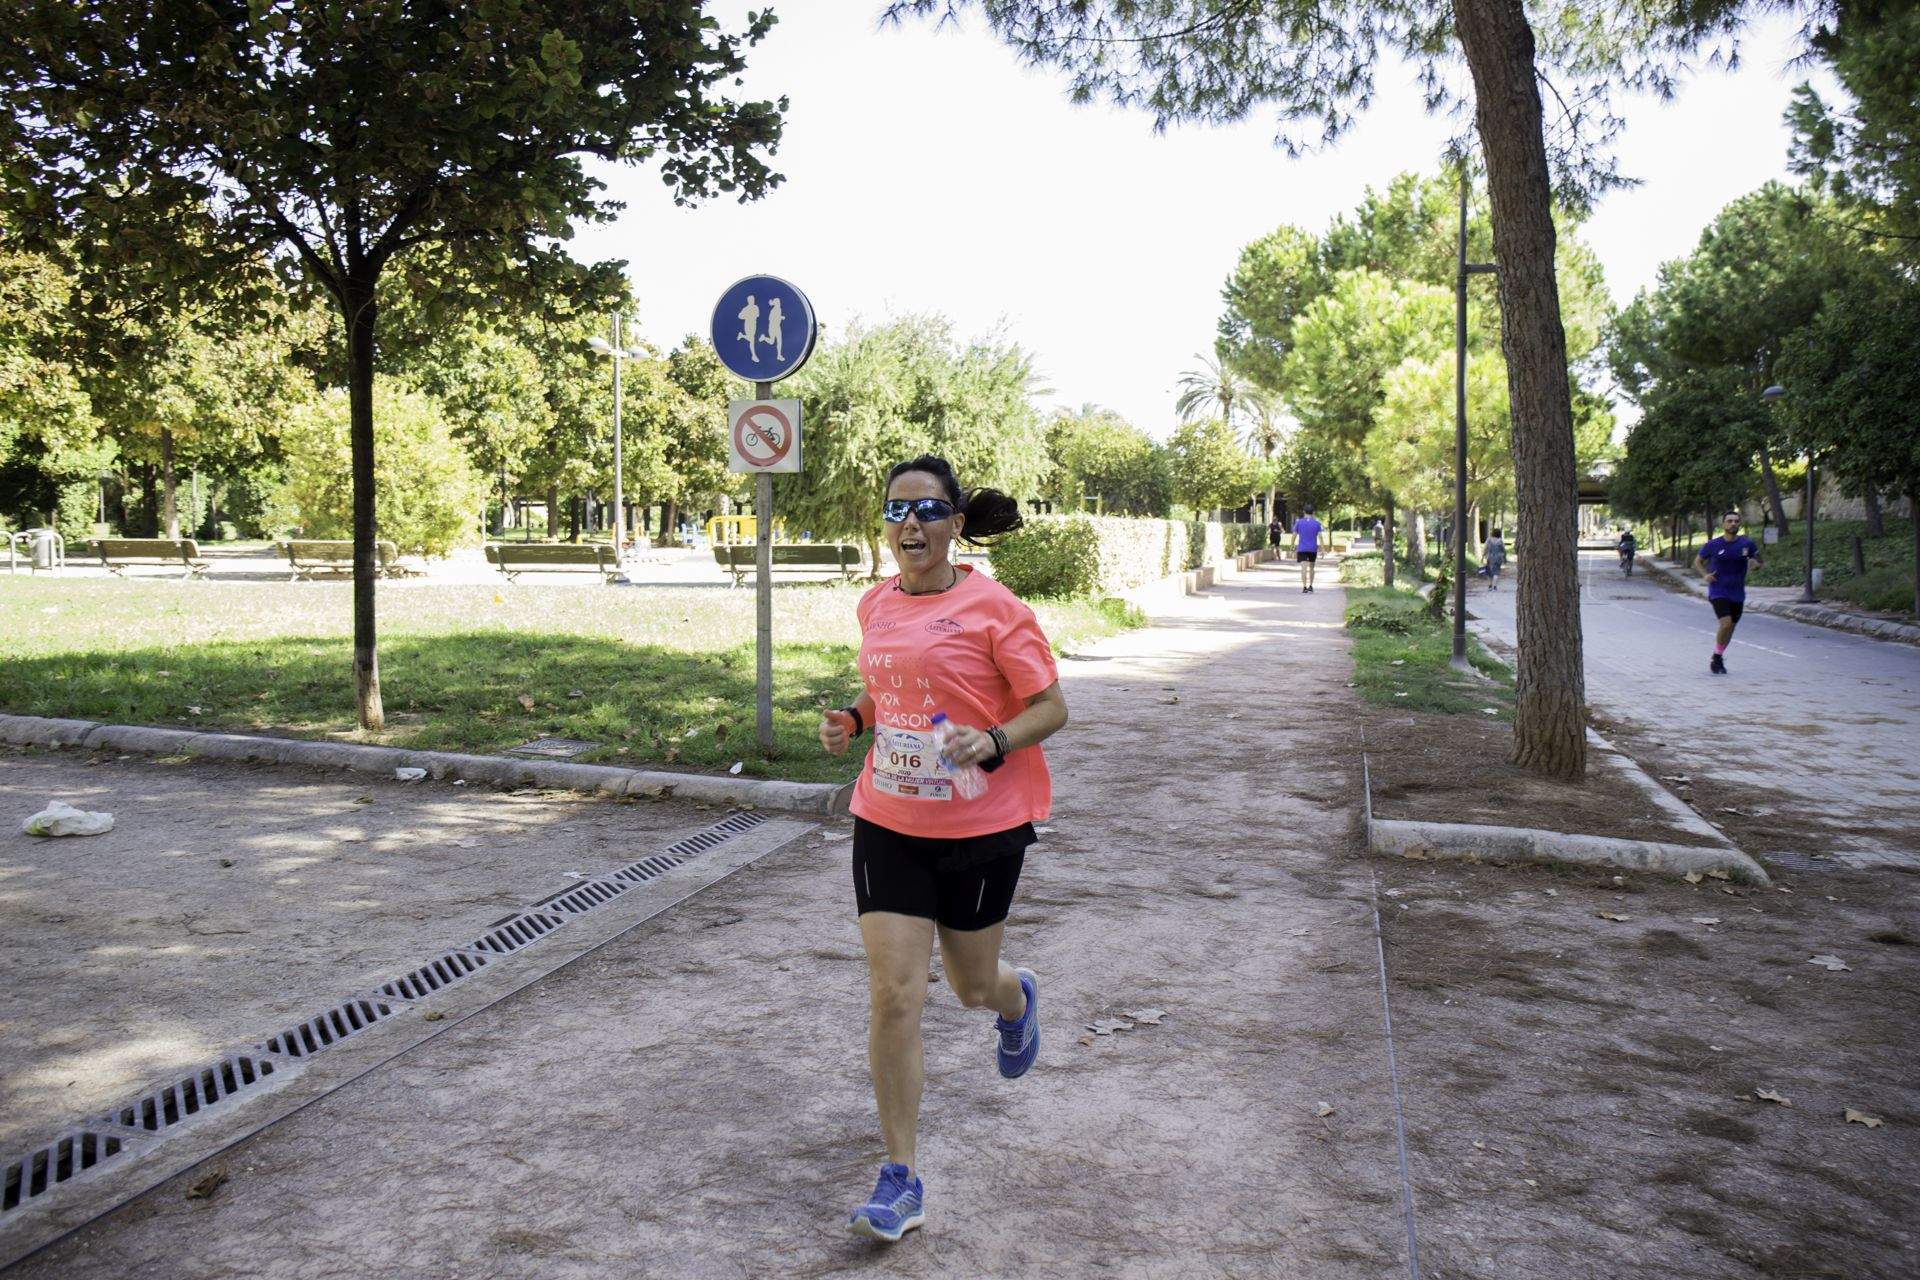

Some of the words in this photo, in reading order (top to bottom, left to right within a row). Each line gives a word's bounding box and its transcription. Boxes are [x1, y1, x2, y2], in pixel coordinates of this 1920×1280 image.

[867, 654, 893, 668] WE
[923, 694, 935, 707] A
[891, 751, 922, 768] 016
